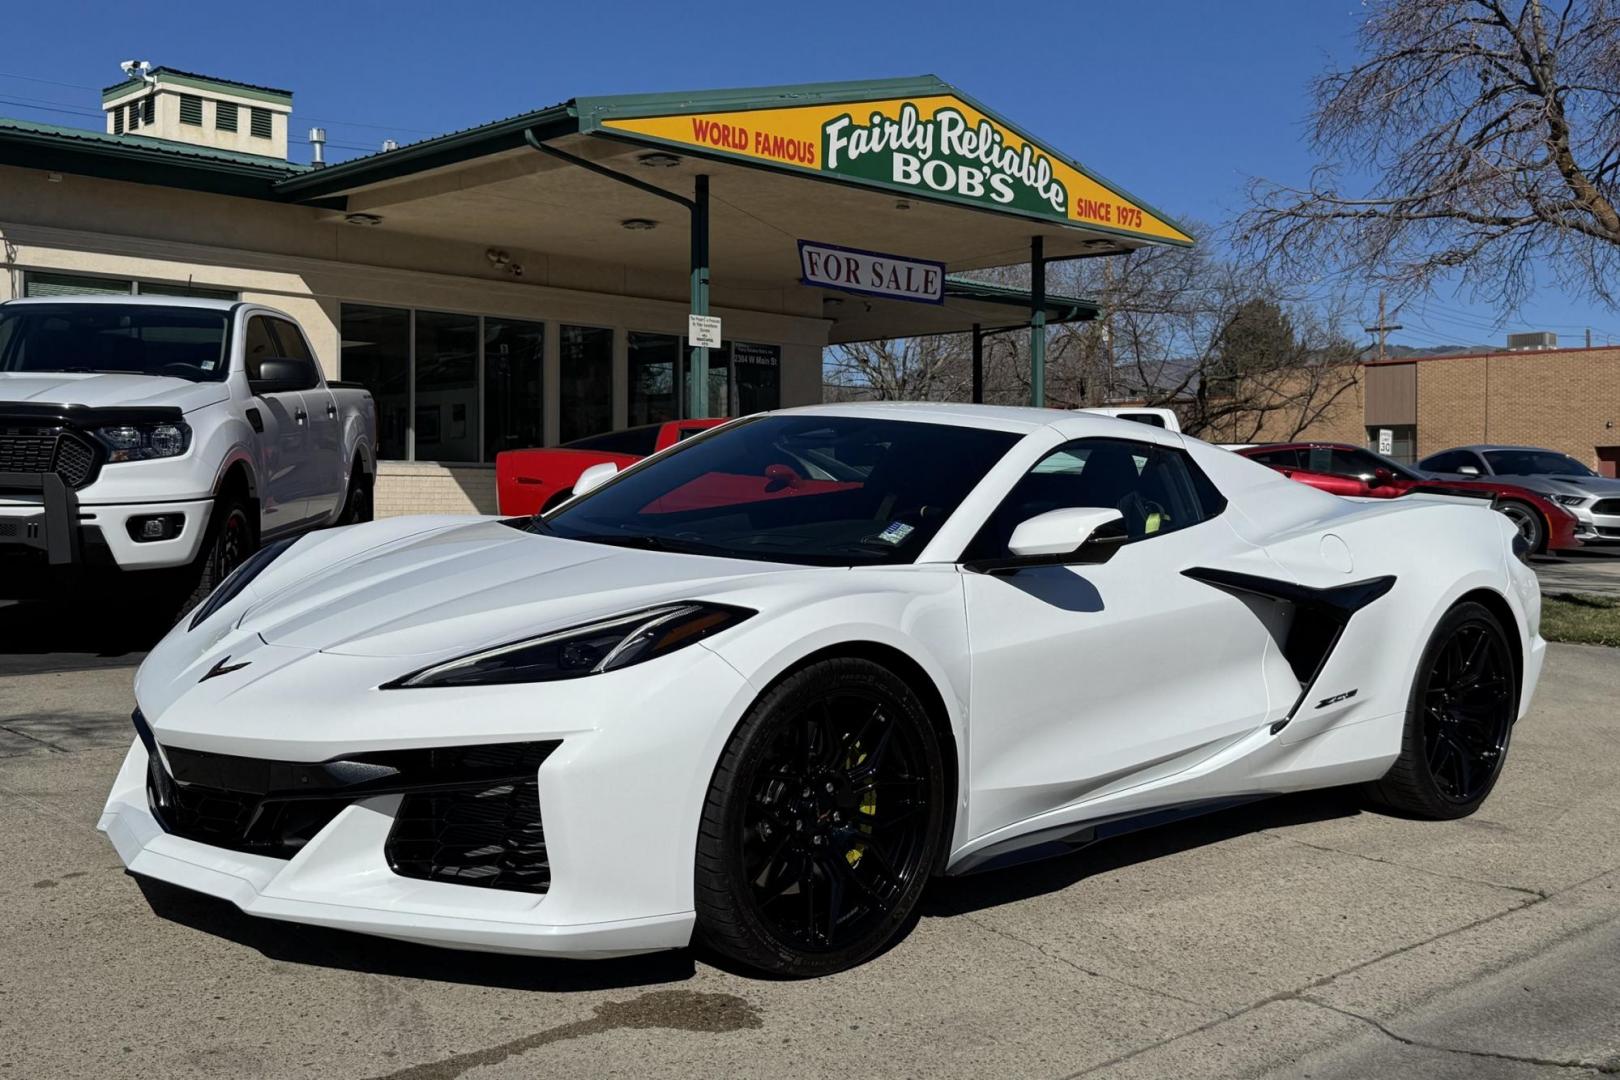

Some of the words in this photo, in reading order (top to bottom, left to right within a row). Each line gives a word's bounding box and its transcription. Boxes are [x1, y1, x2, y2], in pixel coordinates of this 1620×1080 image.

[692, 118, 748, 150] WORLD
[755, 131, 815, 164] FAMOUS
[825, 106, 934, 169] Fairly
[936, 110, 1065, 212] Reliable
[893, 152, 1014, 203] BOB'S
[1077, 198, 1111, 222] SINCE
[1116, 206, 1142, 228] 1975
[807, 251, 861, 284] FOR
[872, 262, 937, 295] SALE
[1381, 442, 1391, 452] 30
